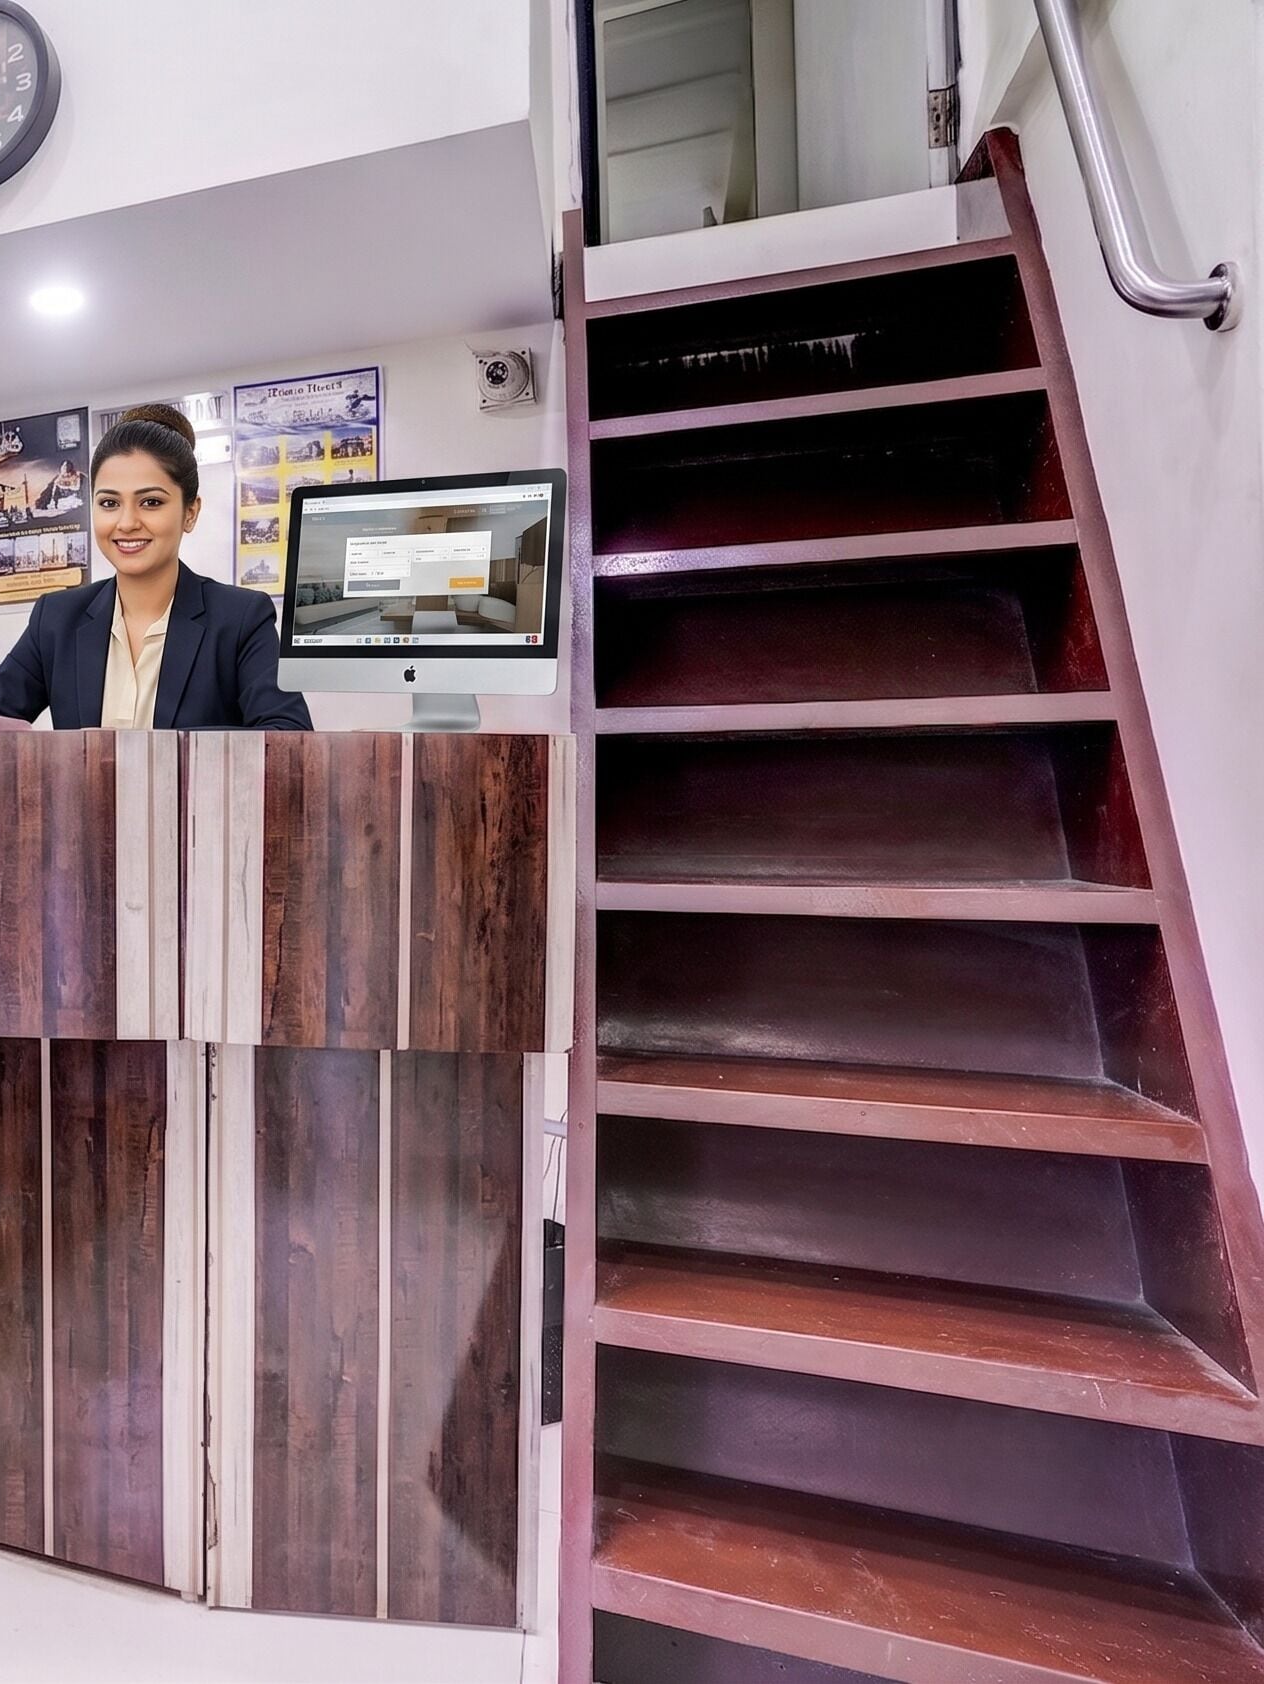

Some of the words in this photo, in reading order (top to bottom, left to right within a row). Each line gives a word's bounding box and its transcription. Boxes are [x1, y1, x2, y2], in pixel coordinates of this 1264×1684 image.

[7, 43, 24, 63] 2
[16, 72, 32, 91] 3
[7, 105, 24, 123] 4
